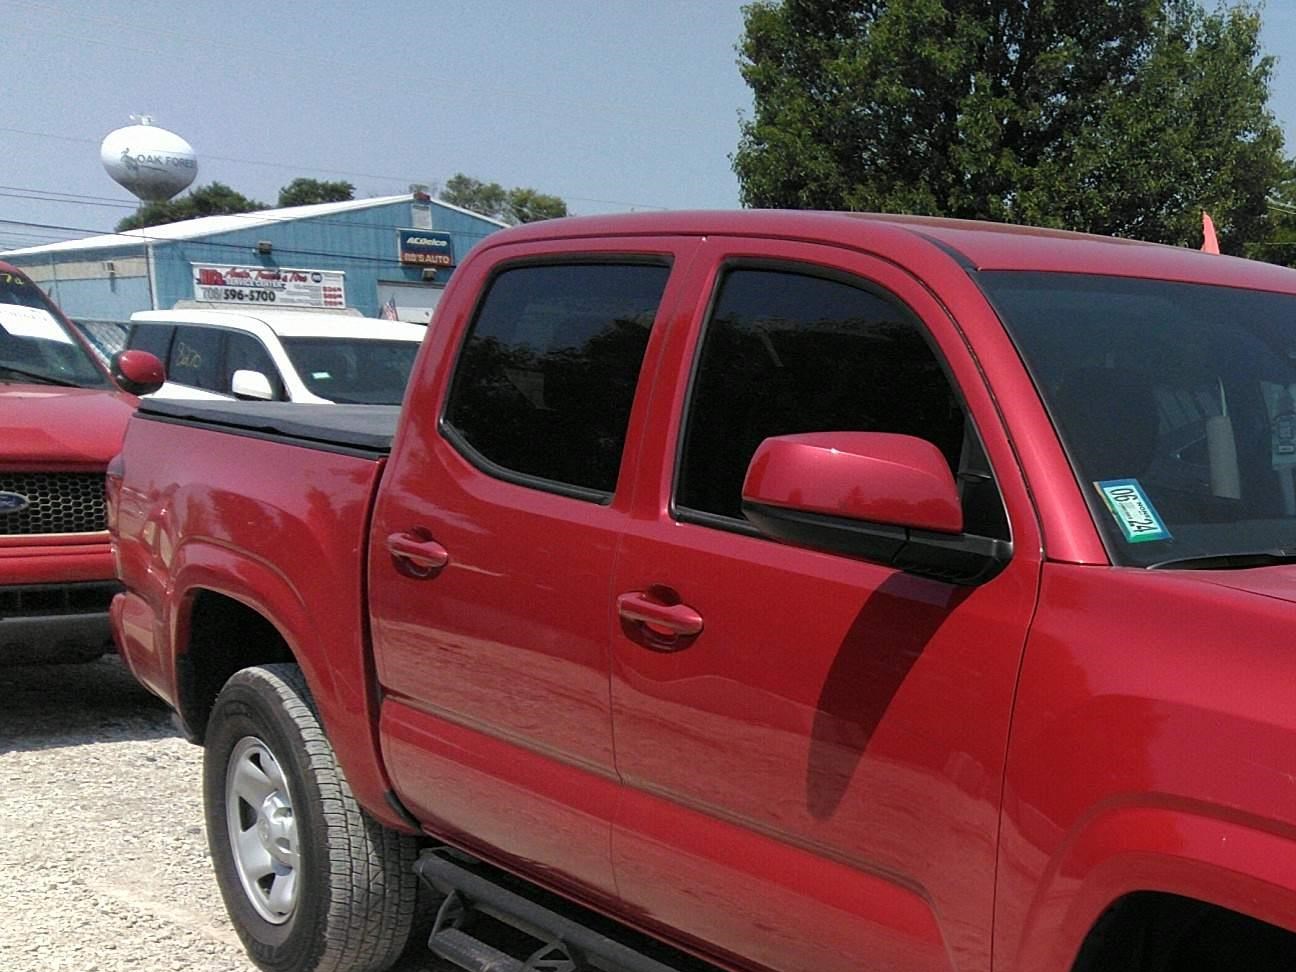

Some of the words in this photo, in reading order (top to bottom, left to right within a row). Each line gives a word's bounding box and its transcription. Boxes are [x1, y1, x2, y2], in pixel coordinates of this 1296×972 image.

[137, 154, 162, 165] OAK
[406, 236, 448, 247] ACDelco
[425, 254, 450, 264] AUTO
[1110, 488, 1139, 502] 06
[1127, 518, 1159, 533] 24
